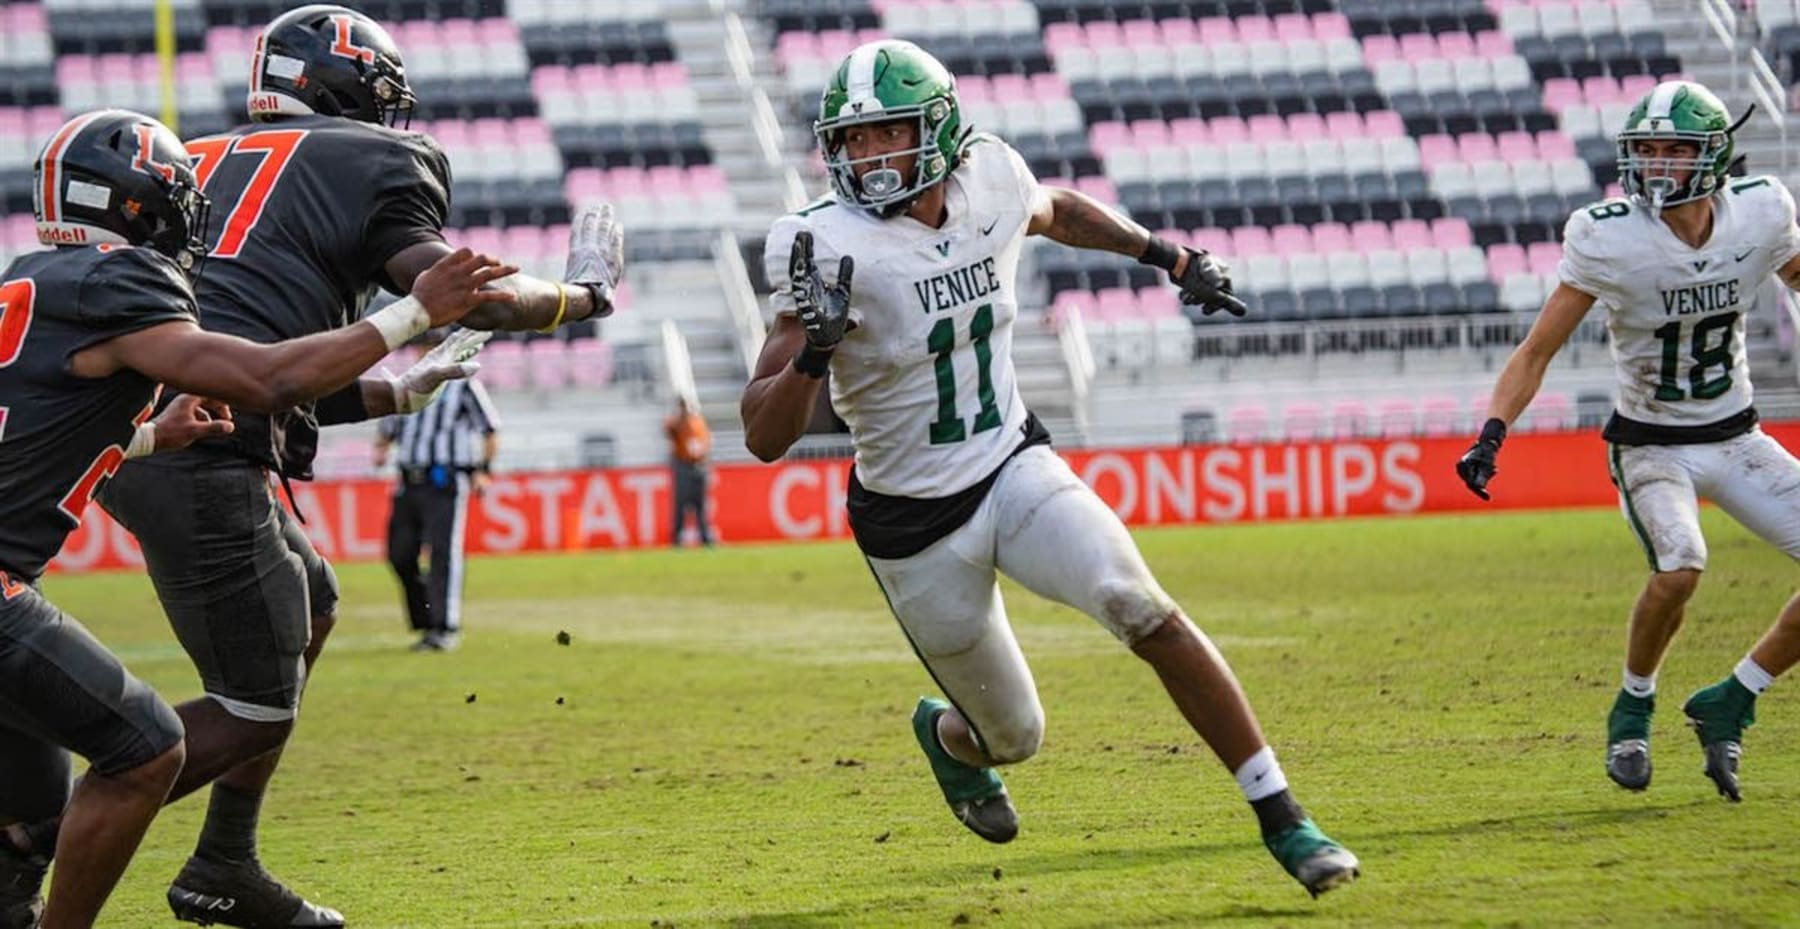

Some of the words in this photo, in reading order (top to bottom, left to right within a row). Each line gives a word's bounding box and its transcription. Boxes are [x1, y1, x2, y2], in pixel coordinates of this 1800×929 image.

[329, 15, 375, 65] L
[131, 123, 176, 187] L
[914, 256, 1001, 315] VENICE
[1661, 279, 1740, 316] VENICE
[927, 302, 1003, 445] 11
[1653, 310, 1740, 402] 18
[480, 466, 721, 553] STAT
